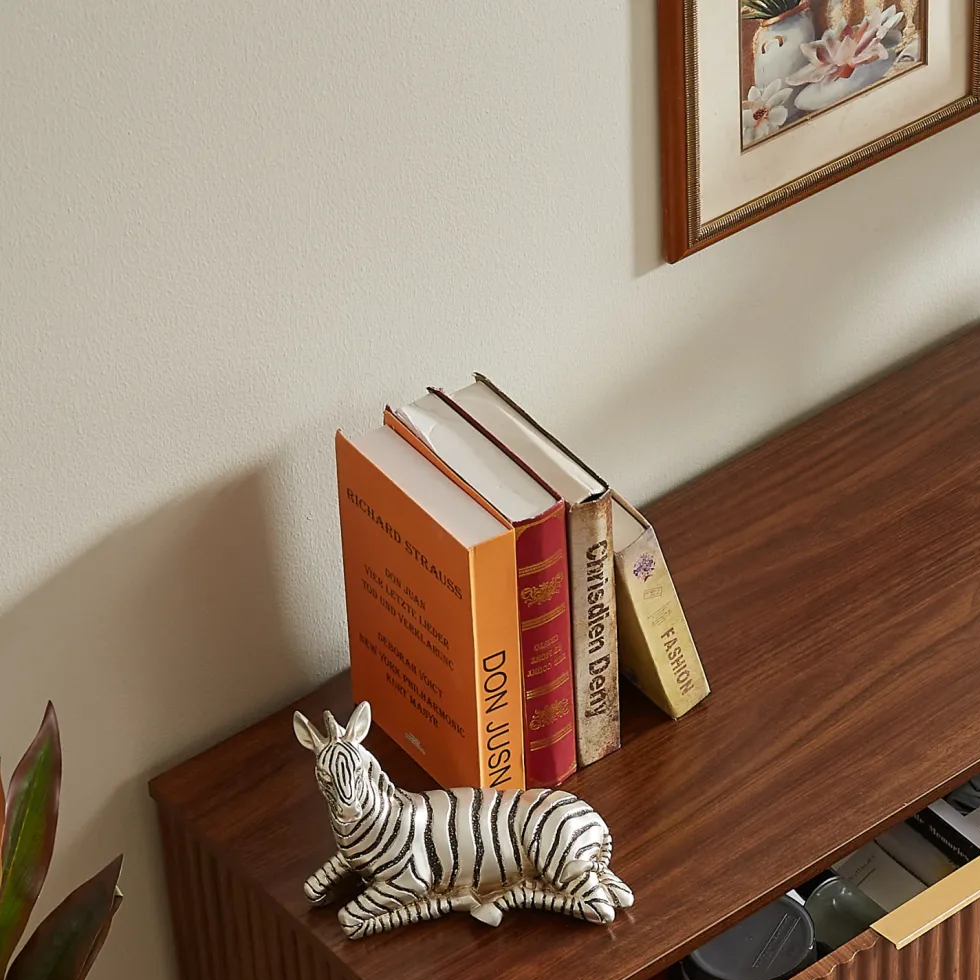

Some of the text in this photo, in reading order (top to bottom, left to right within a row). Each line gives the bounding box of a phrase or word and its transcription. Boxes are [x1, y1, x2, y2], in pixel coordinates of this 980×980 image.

[346, 487, 463, 600] RICHARD STRAUSS
[385, 567, 426, 611] DON JUAN
[385, 584, 418, 620] LETZTE
[419, 615, 450, 651] LIEDER
[379, 650, 401, 677] YORK
[660, 627, 695, 697] FASHION
[482, 649, 513, 789] DON JUSN
